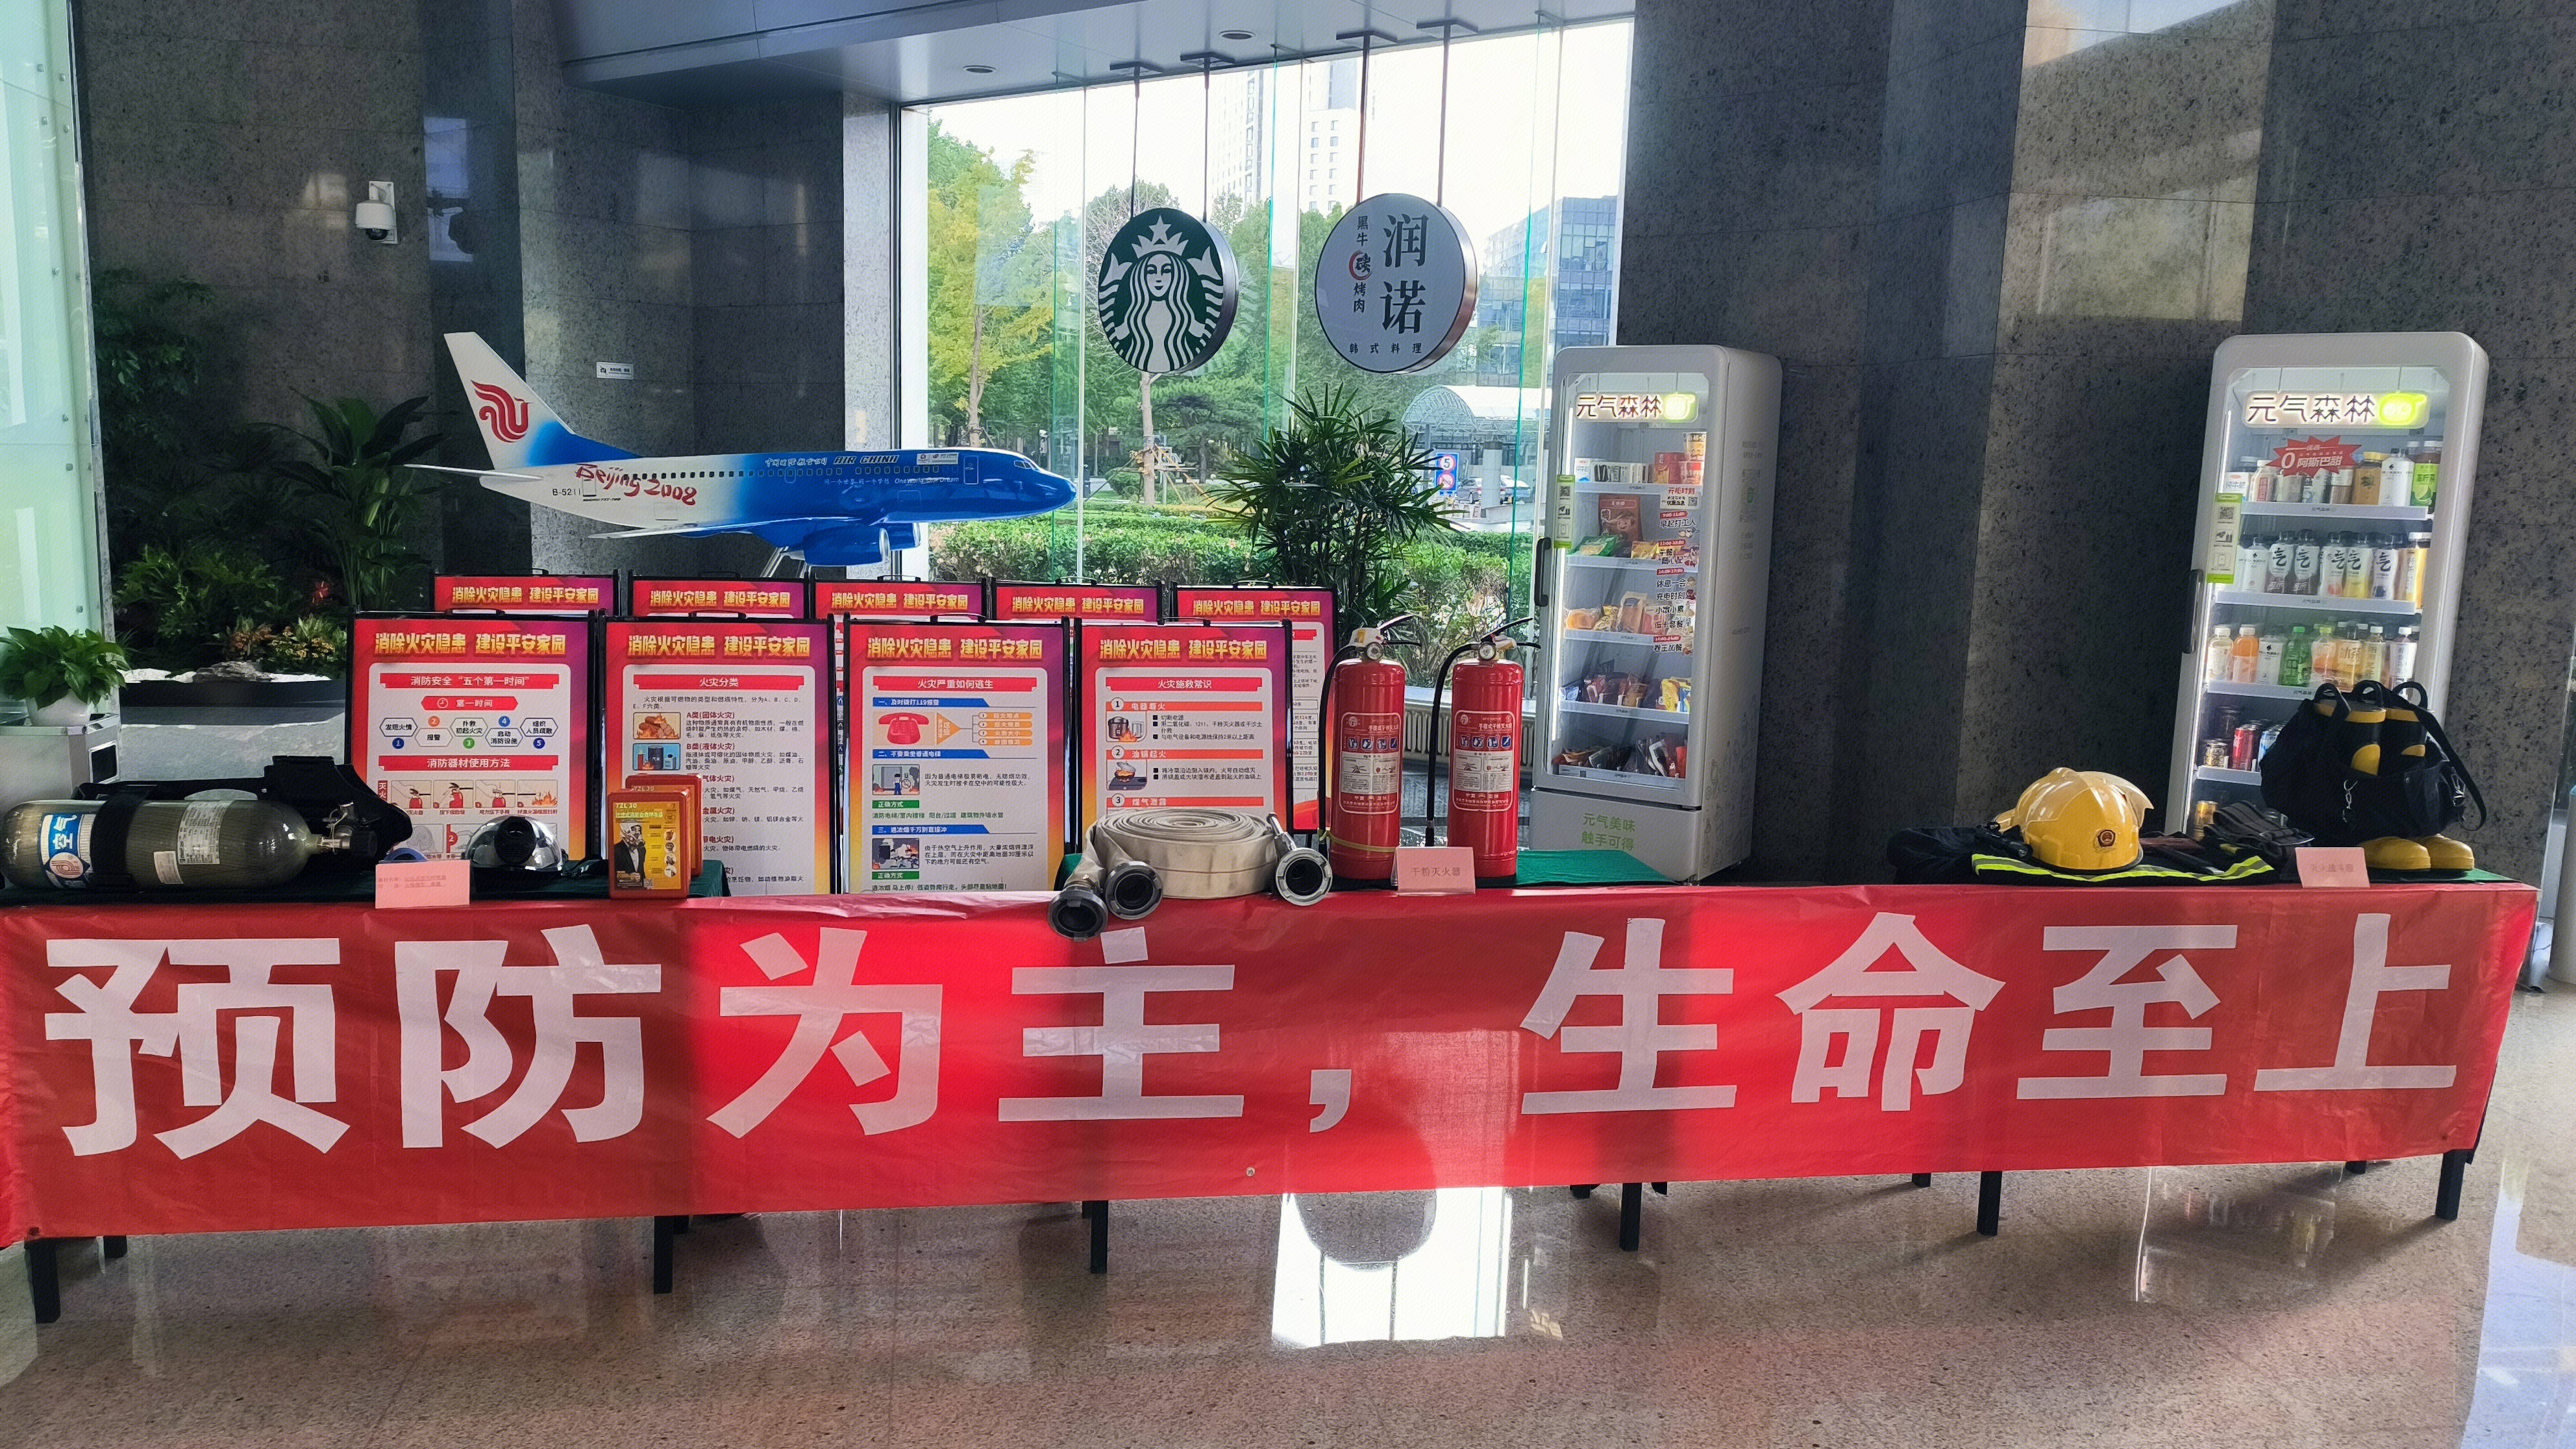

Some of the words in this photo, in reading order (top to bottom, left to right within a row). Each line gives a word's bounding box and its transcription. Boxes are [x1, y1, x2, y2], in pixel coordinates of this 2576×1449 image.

[1352, 216, 1371, 314] 黑牛碳烤肉
[1380, 214, 1429, 334] 润诺
[1349, 342, 1422, 354] 韩式料理
[1576, 395, 1662, 419] 元气森林
[2247, 395, 2375, 423] 元气森林
[834, 456, 857, 465] AIR
[860, 455, 900, 464] CHINA
[1443, 458, 1450, 468] 5
[2281, 452, 2296, 469] 0
[2297, 456, 2343, 468] 阿斯巴甜
[575, 463, 641, 497] Beijing
[643, 478, 697, 506] 2008
[1661, 519, 1696, 528] 早起打工人
[1657, 578, 1687, 588] 休息一会
[452, 586, 523, 604] 消除火灾隐患
[528, 587, 599, 604] 建设平安家园
[650, 590, 718, 607] 消除火灾隐患
[723, 591, 791, 608] 建设平安家园
[832, 591, 897, 609] 消除火灾隐患
[903, 593, 969, 610] 建设平安家园
[1656, 591, 1685, 601] 充电时刻
[1012, 596, 1076, 613] 消除火灾隐患
[1082, 598, 1144, 614] 建设平安家园
[1193, 600, 1254, 616] 消除火灾隐患
[1260, 600, 1320, 616] 建设平安家园
[375, 632, 466, 654] 消除火灾隐患
[475, 634, 566, 656] 建设平安家园
[628, 635, 715, 657] 消除火灾隐患
[724, 636, 811, 658] 建设平安家园
[866, 638, 952, 659] 消除火灾隐患
[960, 638, 1043, 660] 建设平安家园
[1100, 639, 1180, 660] 消除火灾隐患
[1189, 639, 1267, 660] 建设平安家园
[699, 678, 739, 687] 火灾分类
[917, 679, 994, 689] 火灾严重如何逃生
[1158, 680, 1212, 689] 火灾施救常识
[456, 699, 493, 708] 第一时间
[427, 758, 511, 769] 消防器材使用方法
[1582, 812, 1636, 832] 元气美味
[53, 814, 77, 850] 空气
[1581, 830, 1635, 851] 触手可得
[1411, 866, 1461, 878] 干粉灭火器
[2310, 863, 2355, 873] 灭火战斗服
[45, 912, 2457, 1159] 预防为主，生命至上
